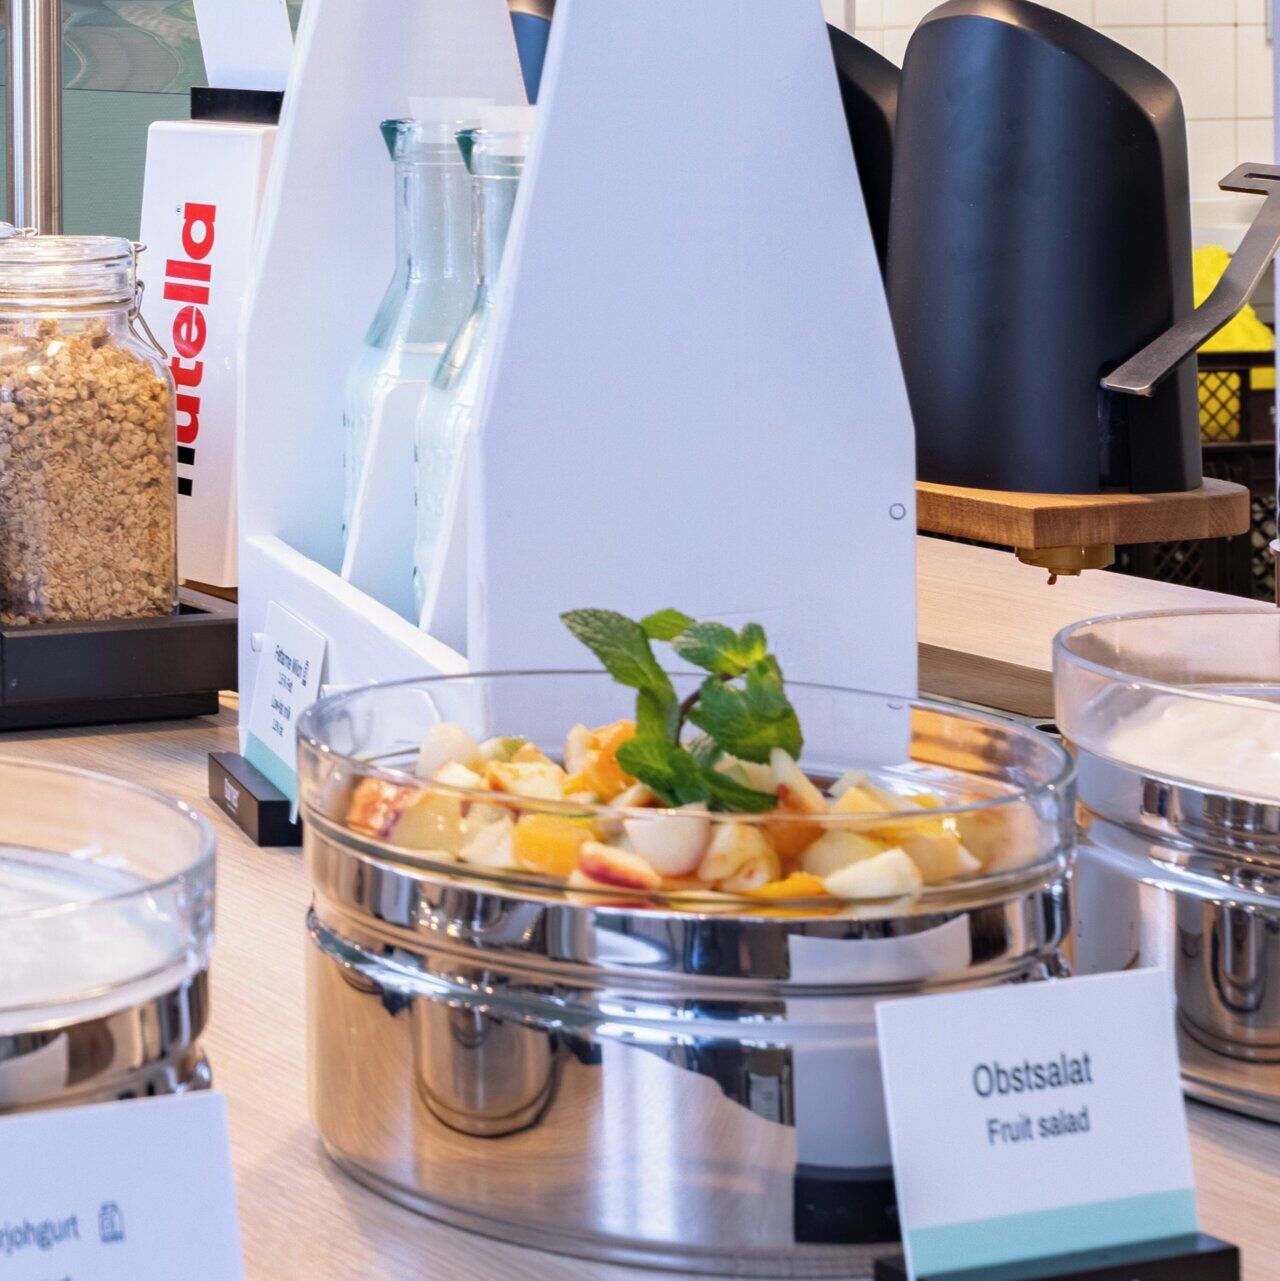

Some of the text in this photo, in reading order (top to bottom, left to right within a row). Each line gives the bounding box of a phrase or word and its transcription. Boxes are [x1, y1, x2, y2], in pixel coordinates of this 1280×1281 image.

[972, 1051, 1094, 1098] Obstsalat
[986, 1104, 1091, 1146] Fruit salad
